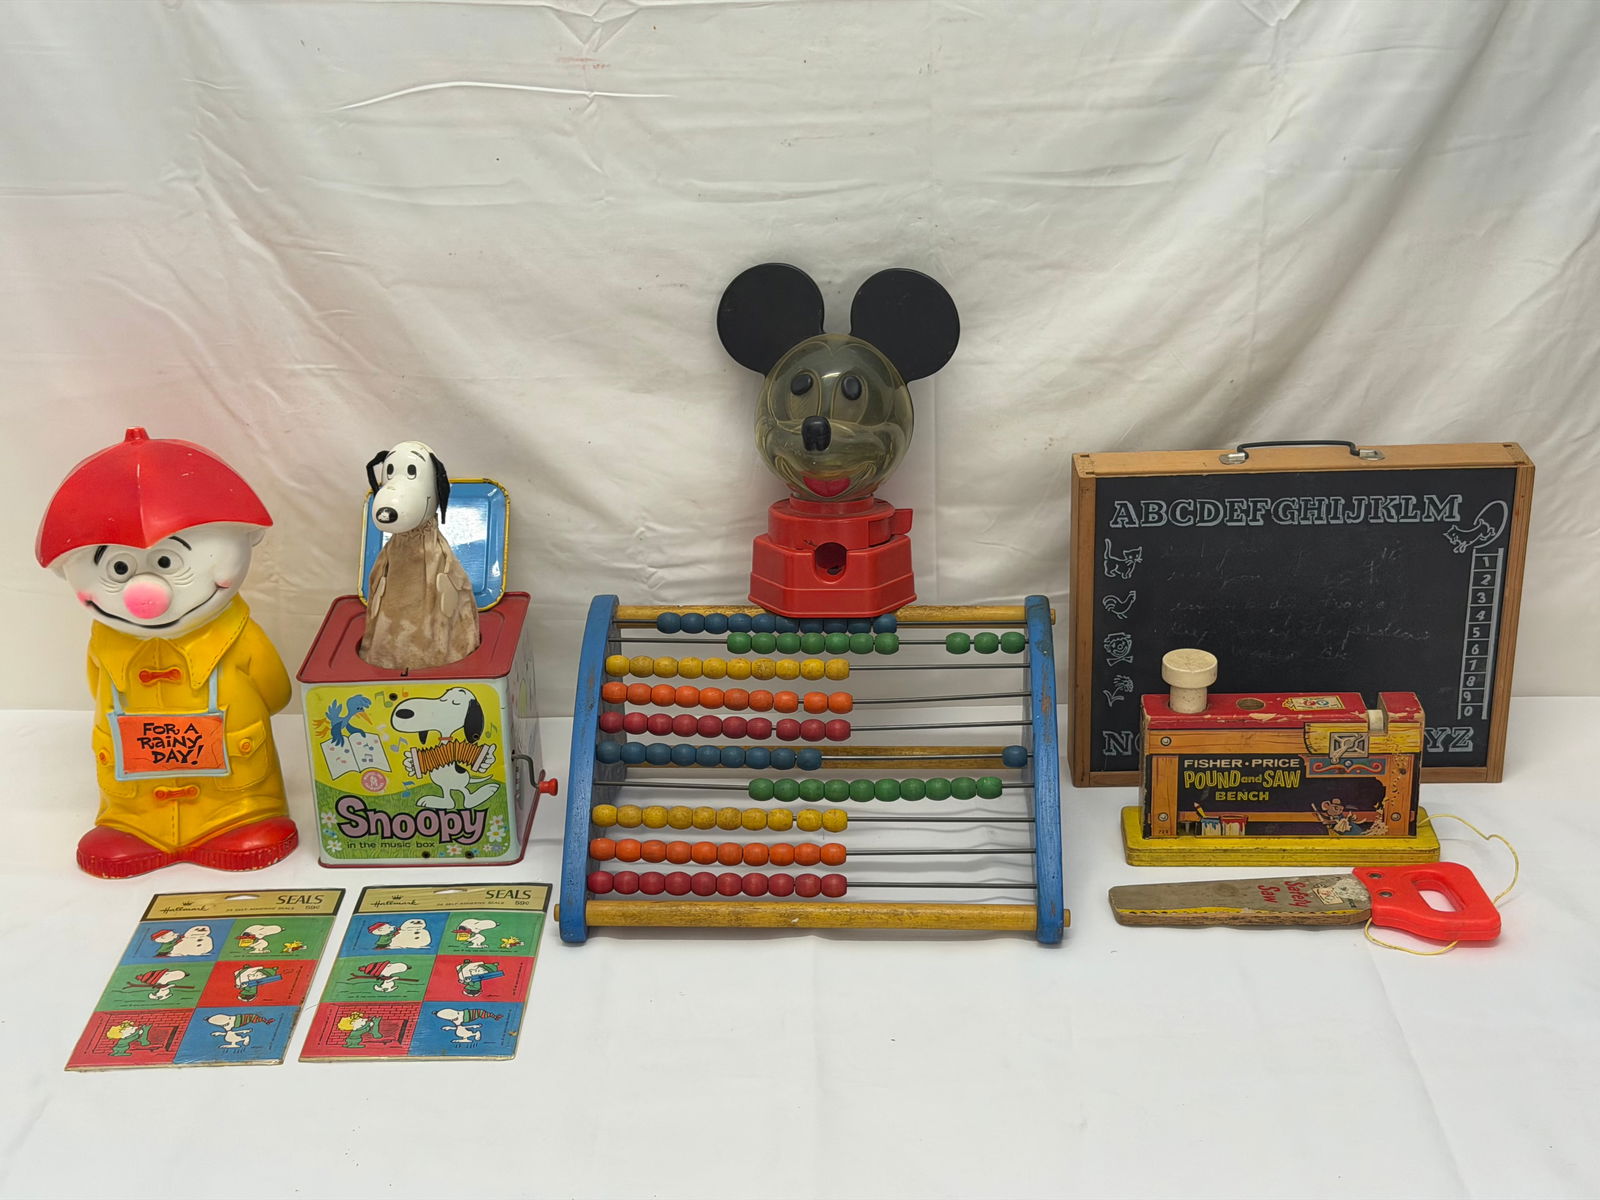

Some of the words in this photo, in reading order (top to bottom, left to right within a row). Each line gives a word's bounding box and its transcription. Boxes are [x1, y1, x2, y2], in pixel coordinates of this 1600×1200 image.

[1109, 494, 1463, 528] ABCDEFGHIJKLM
[1482, 556, 1490, 567] 1
[1480, 574, 1492, 585] 2
[1477, 592, 1486, 603] 3
[1475, 610, 1486, 621] 4
[1472, 627, 1481, 638] 5
[1471, 644, 1480, 655] 6
[1468, 660, 1478, 671] 7
[1466, 676, 1476, 687] 8
[1463, 691, 1472, 702] 9
[1464, 706, 1473, 717] 0
[143, 722, 180, 736] FOR
[184, 723, 199, 734] A
[151, 745, 204, 766] DAY!
[1183, 770, 1241, 790] POUND
[1241, 774, 1262, 784] and
[1262, 769, 1301, 788] SAW
[1215, 791, 1270, 801] BENCH
[335, 795, 489, 845] Snoopy
[346, 841, 357, 849] in
[359, 841, 377, 849] the
[276, 894, 325, 905] SEALS
[484, 889, 532, 900] SEALS
[1257, 884, 1281, 904] Saw
[370, 898, 420, 908] Hallmark
[160, 905, 210, 914] Hallmark
